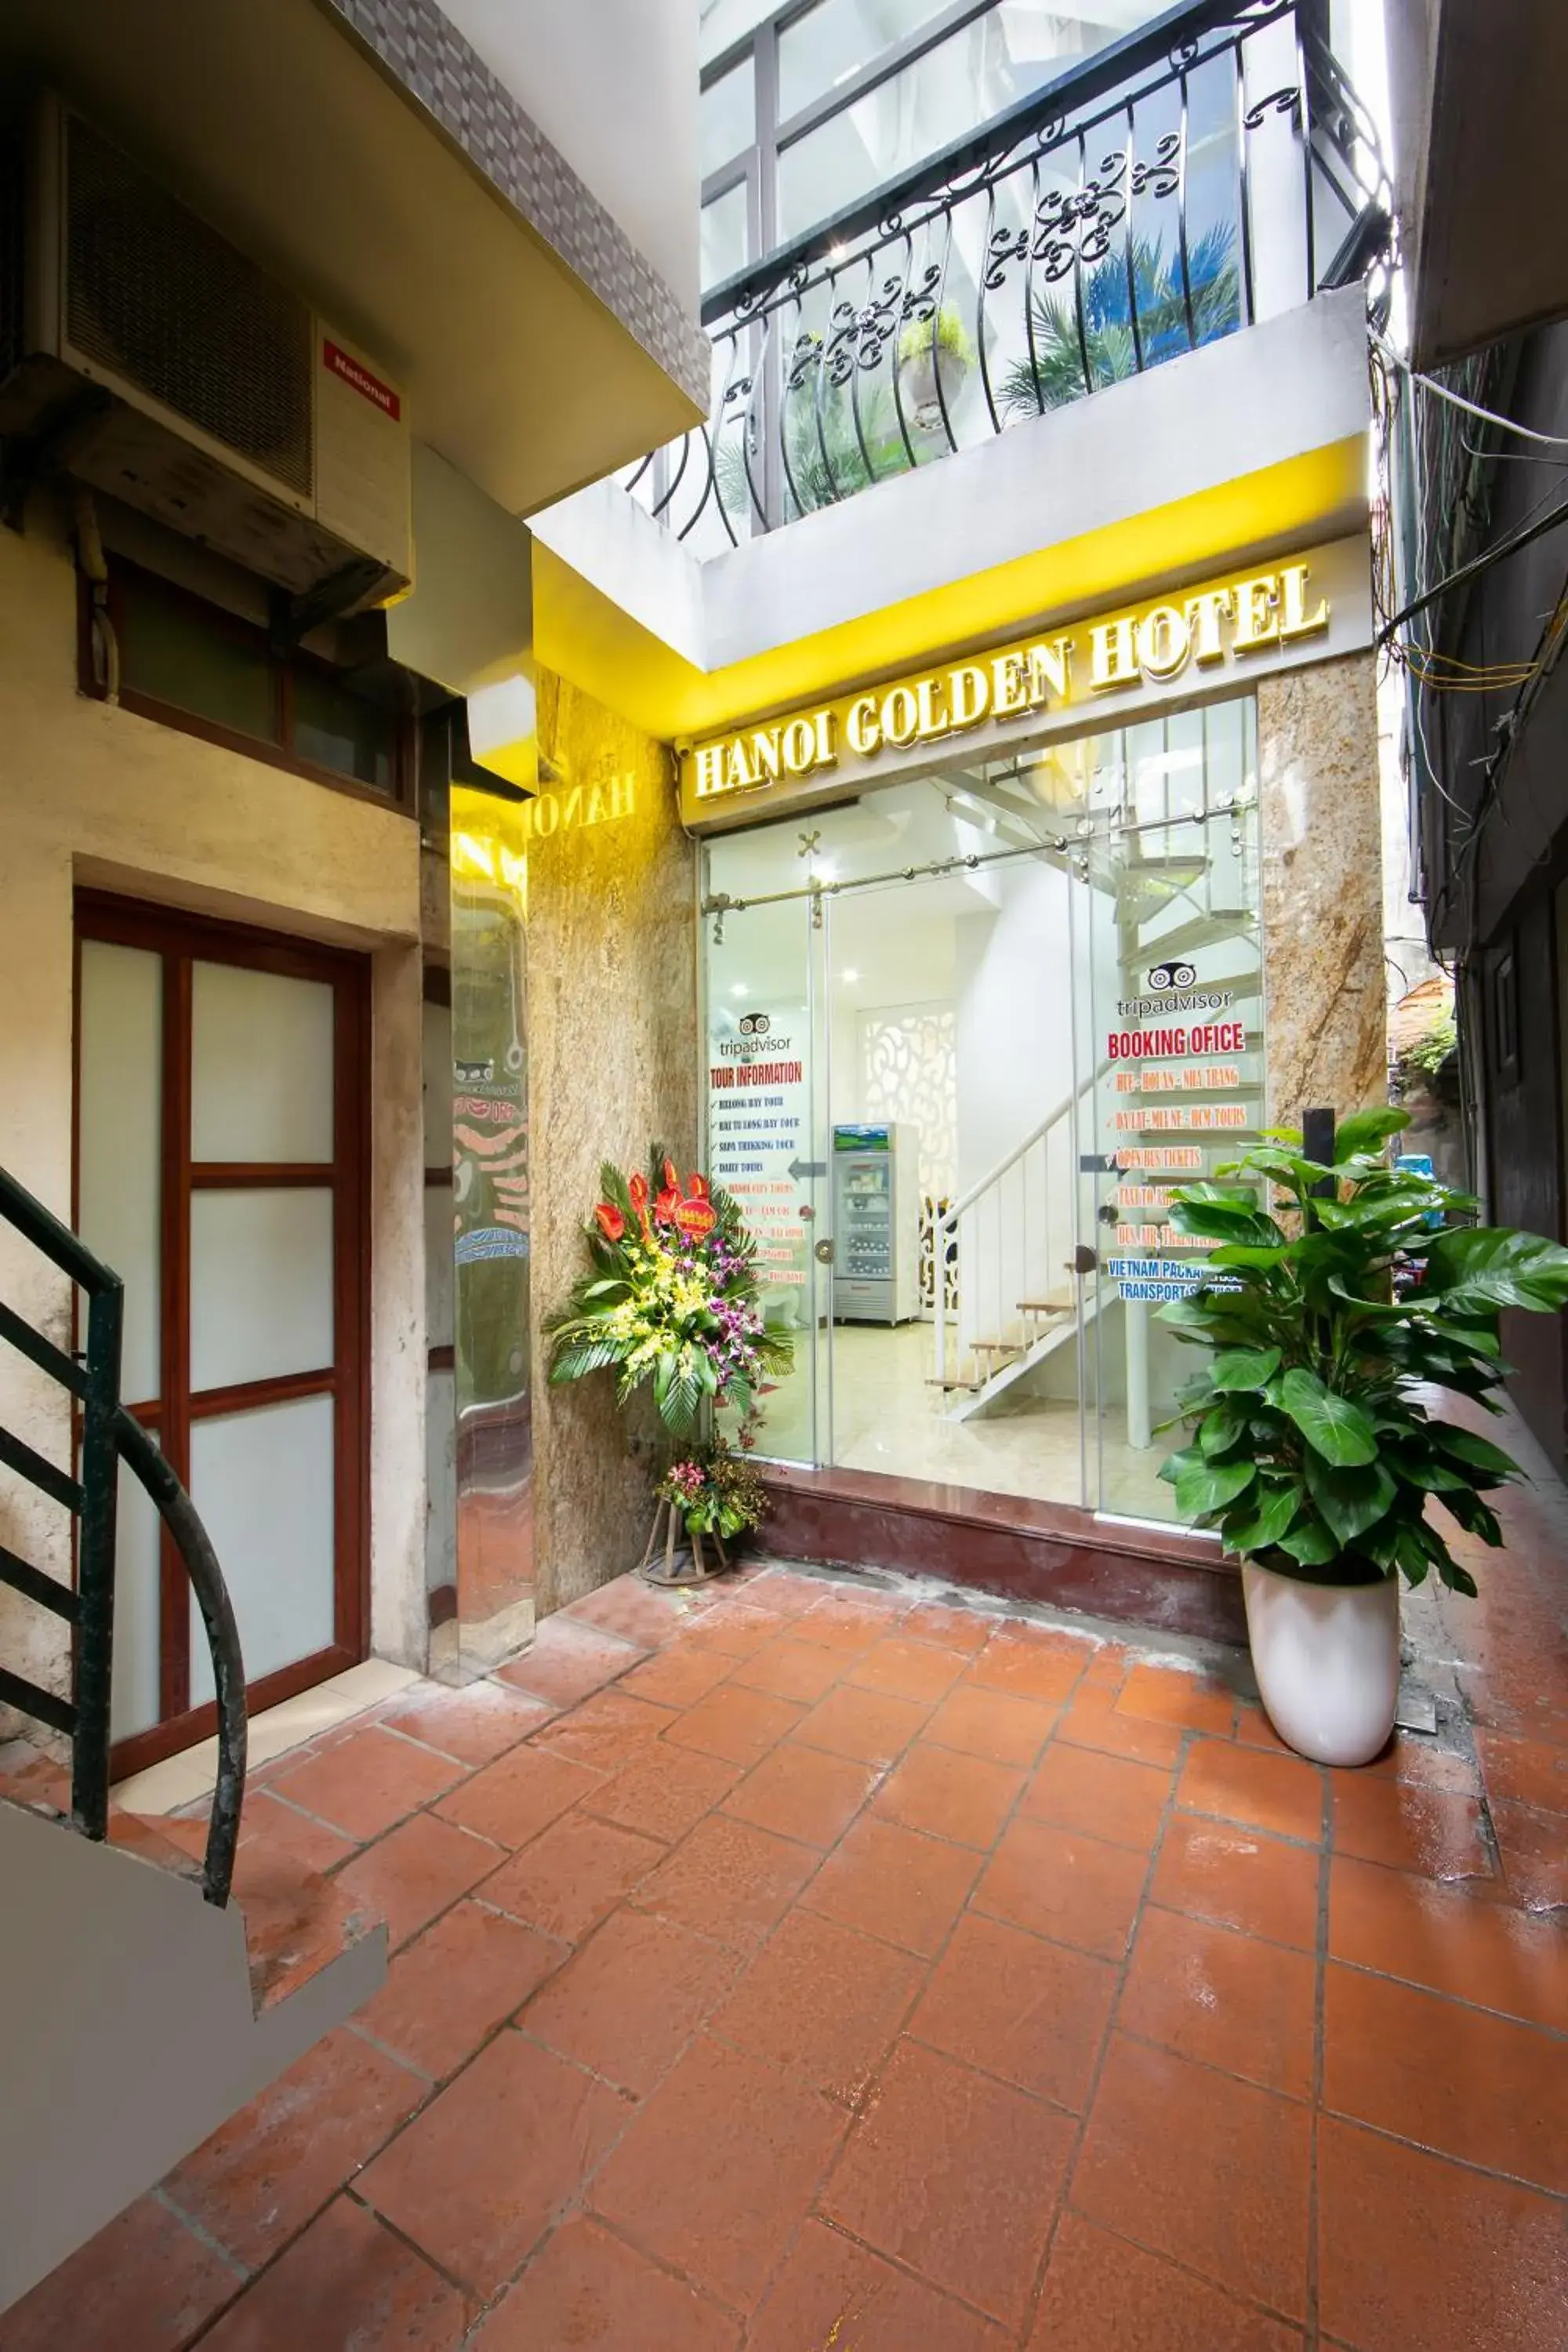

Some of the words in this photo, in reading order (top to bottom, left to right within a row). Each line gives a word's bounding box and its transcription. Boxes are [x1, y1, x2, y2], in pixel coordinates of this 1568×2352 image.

[695, 709, 837, 800] HANOI
[846, 636, 1074, 755] GOLDEN
[1089, 564, 1330, 690] HOTEL
[1117, 991, 1232, 1018] tripadvisor
[720, 1036, 791, 1057] tripadvisor
[1108, 1027, 1186, 1059] BOOKING
[1190, 1022, 1245, 1054] OFICE
[710, 1067, 735, 1090] TOUR
[736, 1061, 802, 1087] INFORMATION
[1109, 1259, 1159, 1277] VIETNAM
[1120, 1282, 1185, 1301] TRANSPORT
